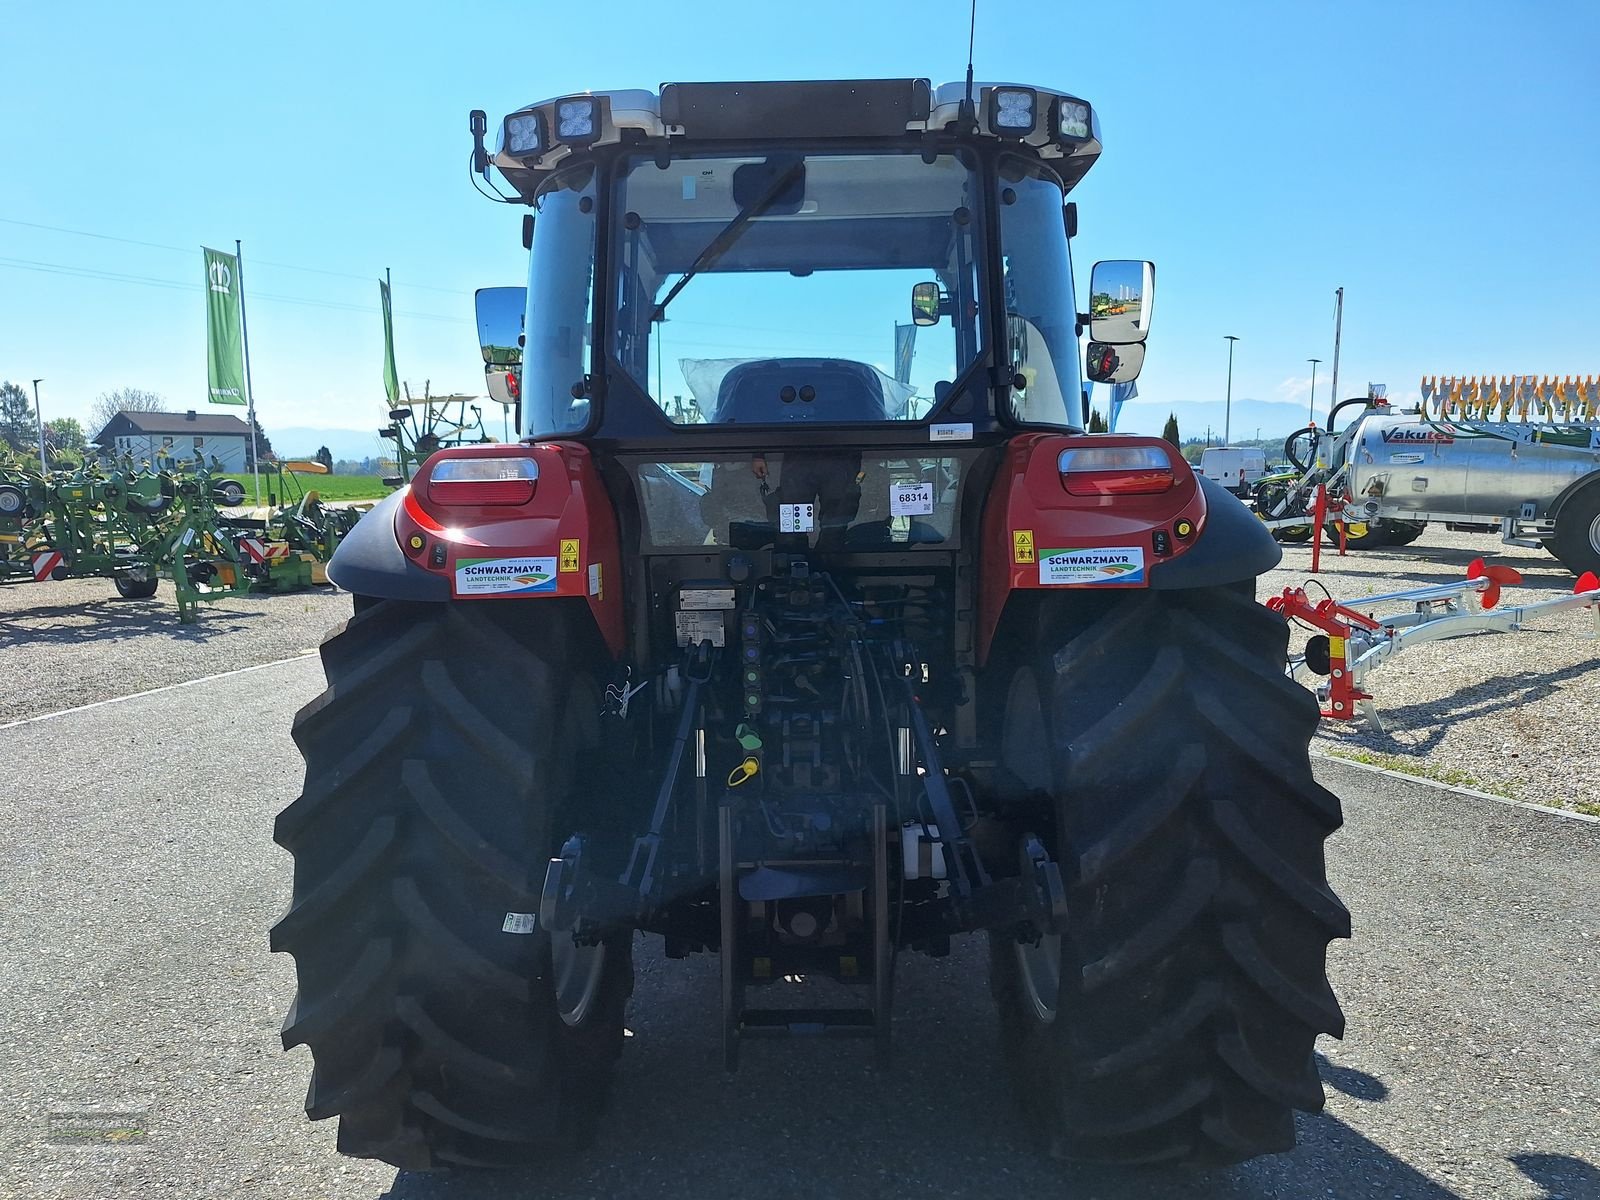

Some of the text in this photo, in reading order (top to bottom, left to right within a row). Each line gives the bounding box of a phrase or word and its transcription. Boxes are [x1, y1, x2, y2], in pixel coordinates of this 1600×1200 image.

[899, 493, 929, 503] 68314
[1048, 555, 1129, 565] SCHWARZMAYR
[464, 565, 542, 575] SCHWARZMAYR
[466, 575, 511, 583] LANDTECHNIK
